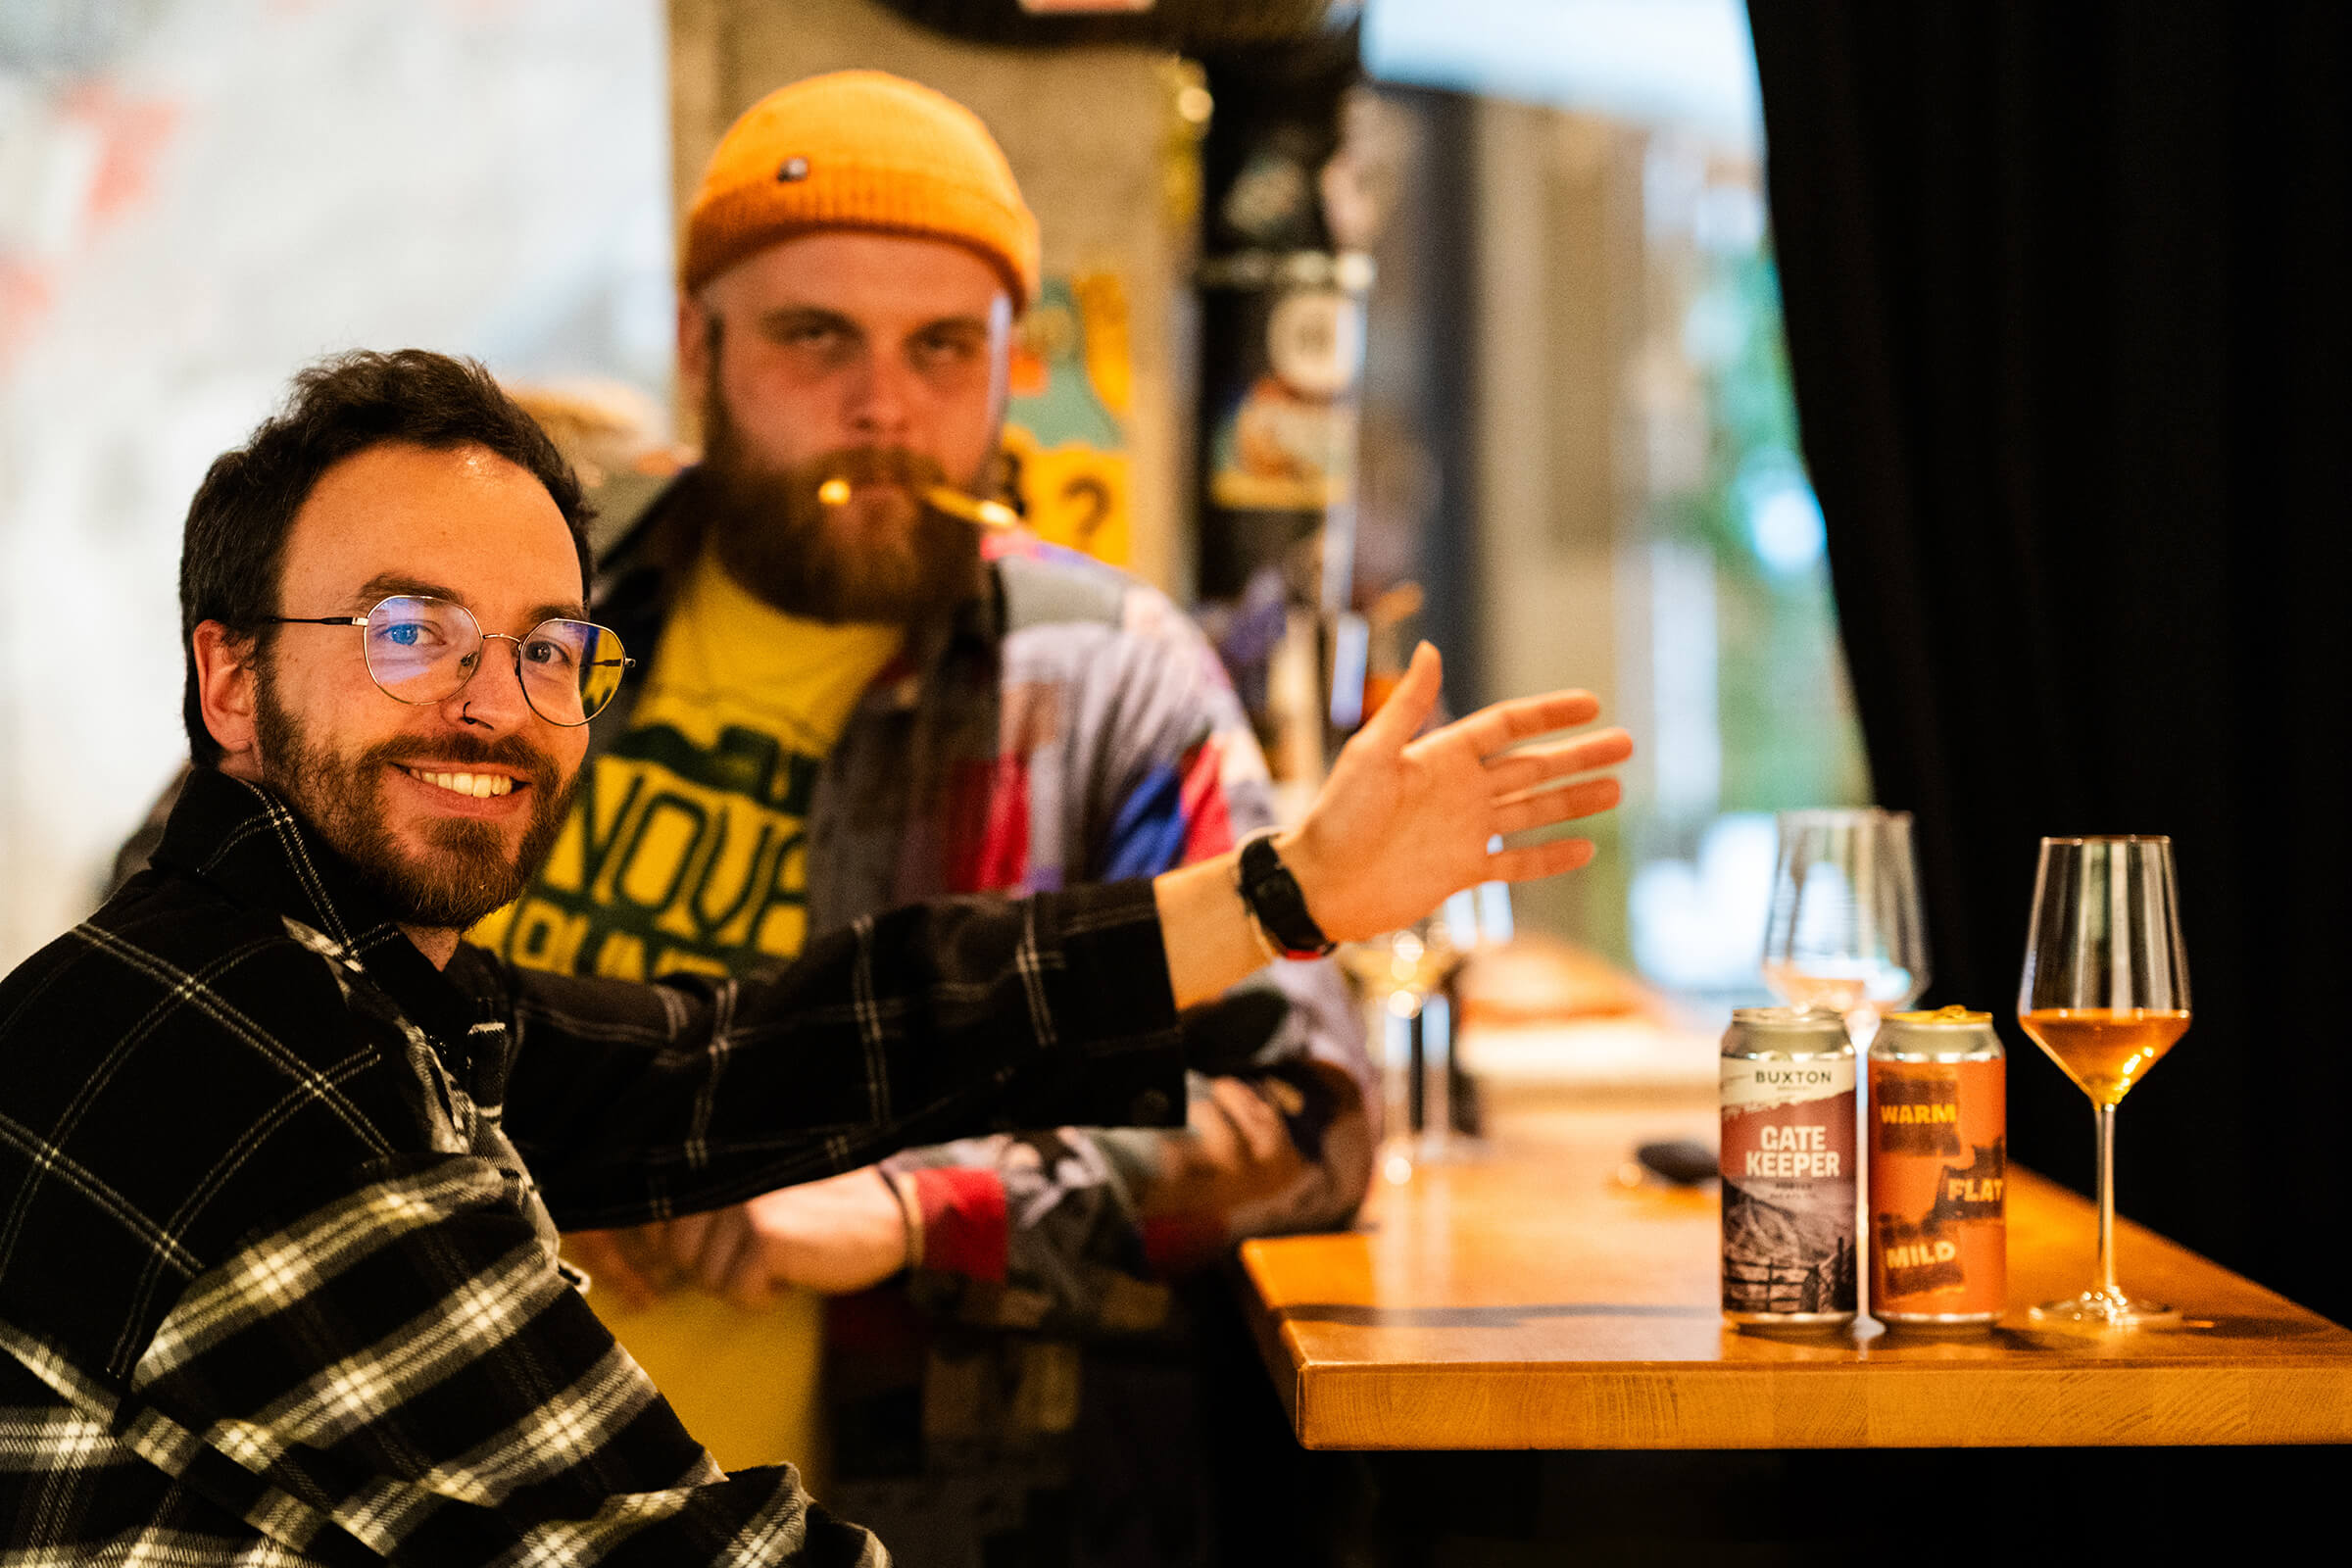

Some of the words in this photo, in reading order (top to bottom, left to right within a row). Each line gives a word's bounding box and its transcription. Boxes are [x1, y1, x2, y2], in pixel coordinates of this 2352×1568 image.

[1755, 1070, 1832, 1084] BUXTON
[1881, 1103, 1957, 1125] WARM
[1760, 1125, 1827, 1152] GATE
[1745, 1151, 1840, 1178] KEEPER
[1947, 1178, 2004, 1202] FLAT
[1886, 1240, 1957, 1269] MILD
